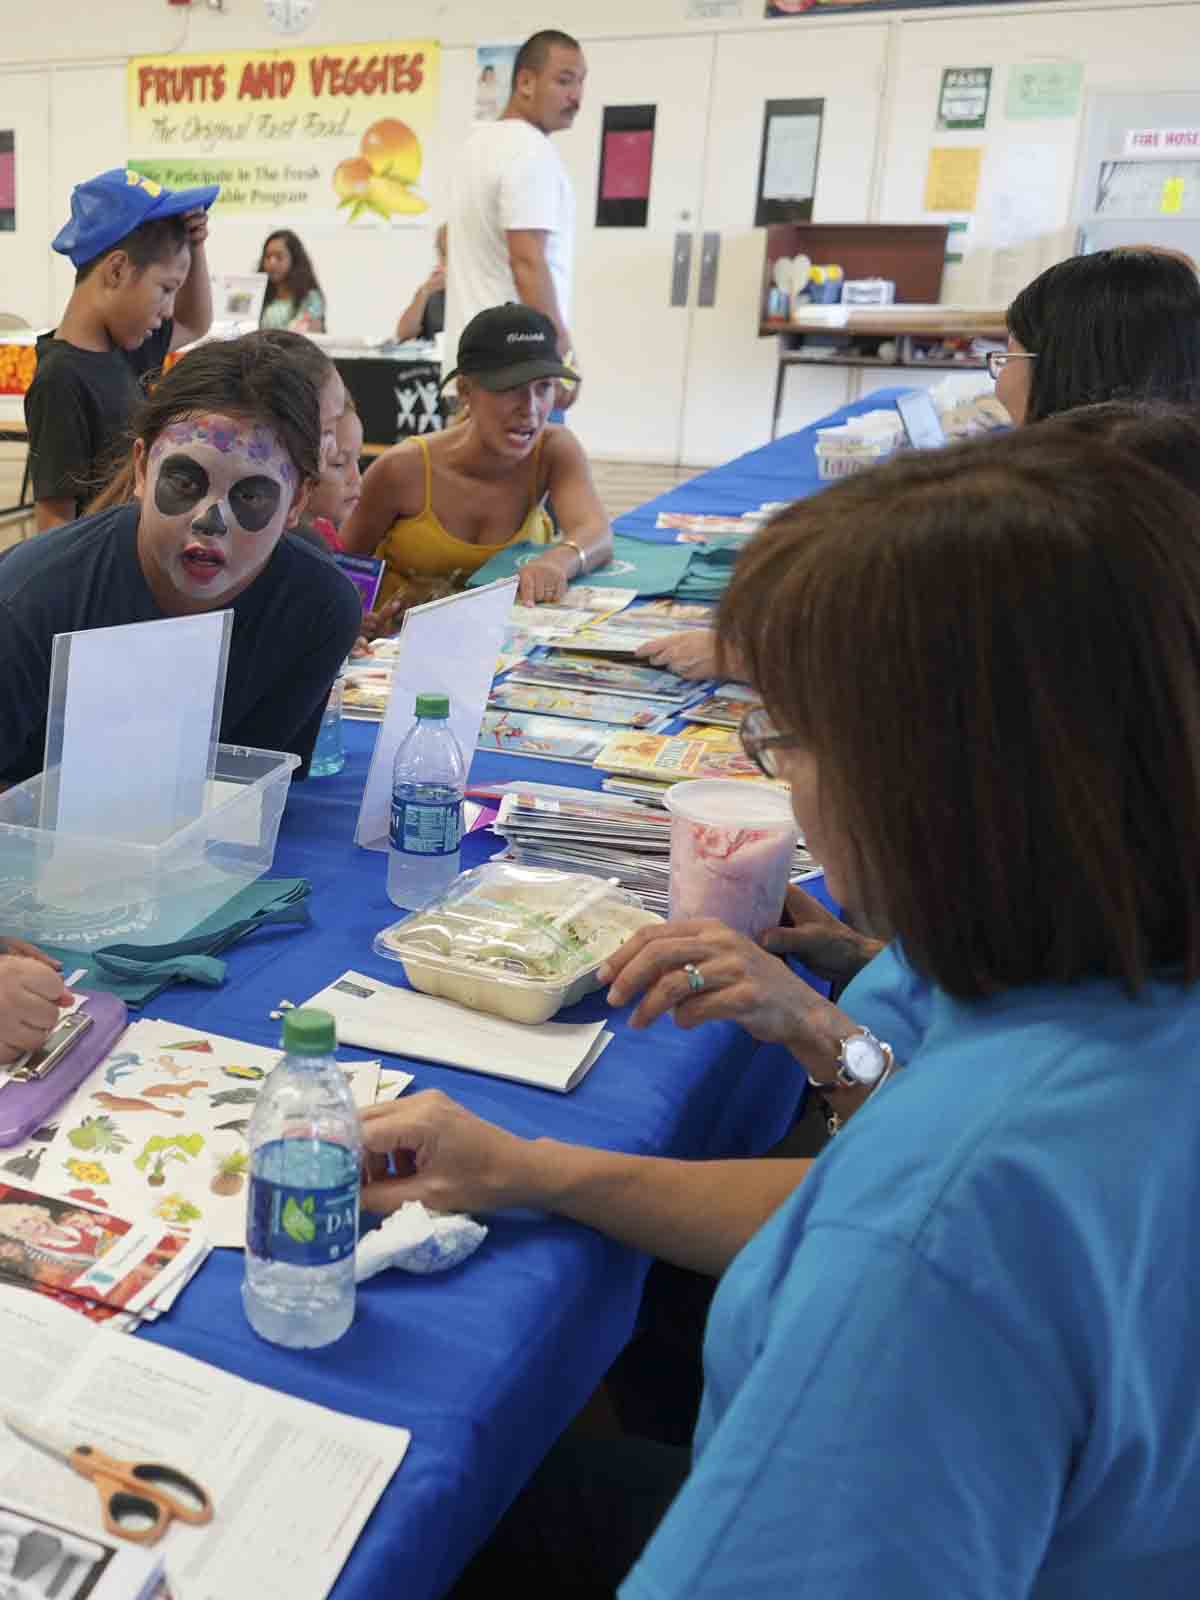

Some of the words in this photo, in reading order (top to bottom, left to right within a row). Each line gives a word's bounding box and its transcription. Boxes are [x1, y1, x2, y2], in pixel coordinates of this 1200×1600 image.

[138, 65, 228, 107] FRUITS
[236, 60, 296, 100] AND
[308, 53, 424, 98] VEGGIES
[151, 114, 177, 143] The
[257, 111, 298, 138] Fast
[252, 190, 309, 207] Program
